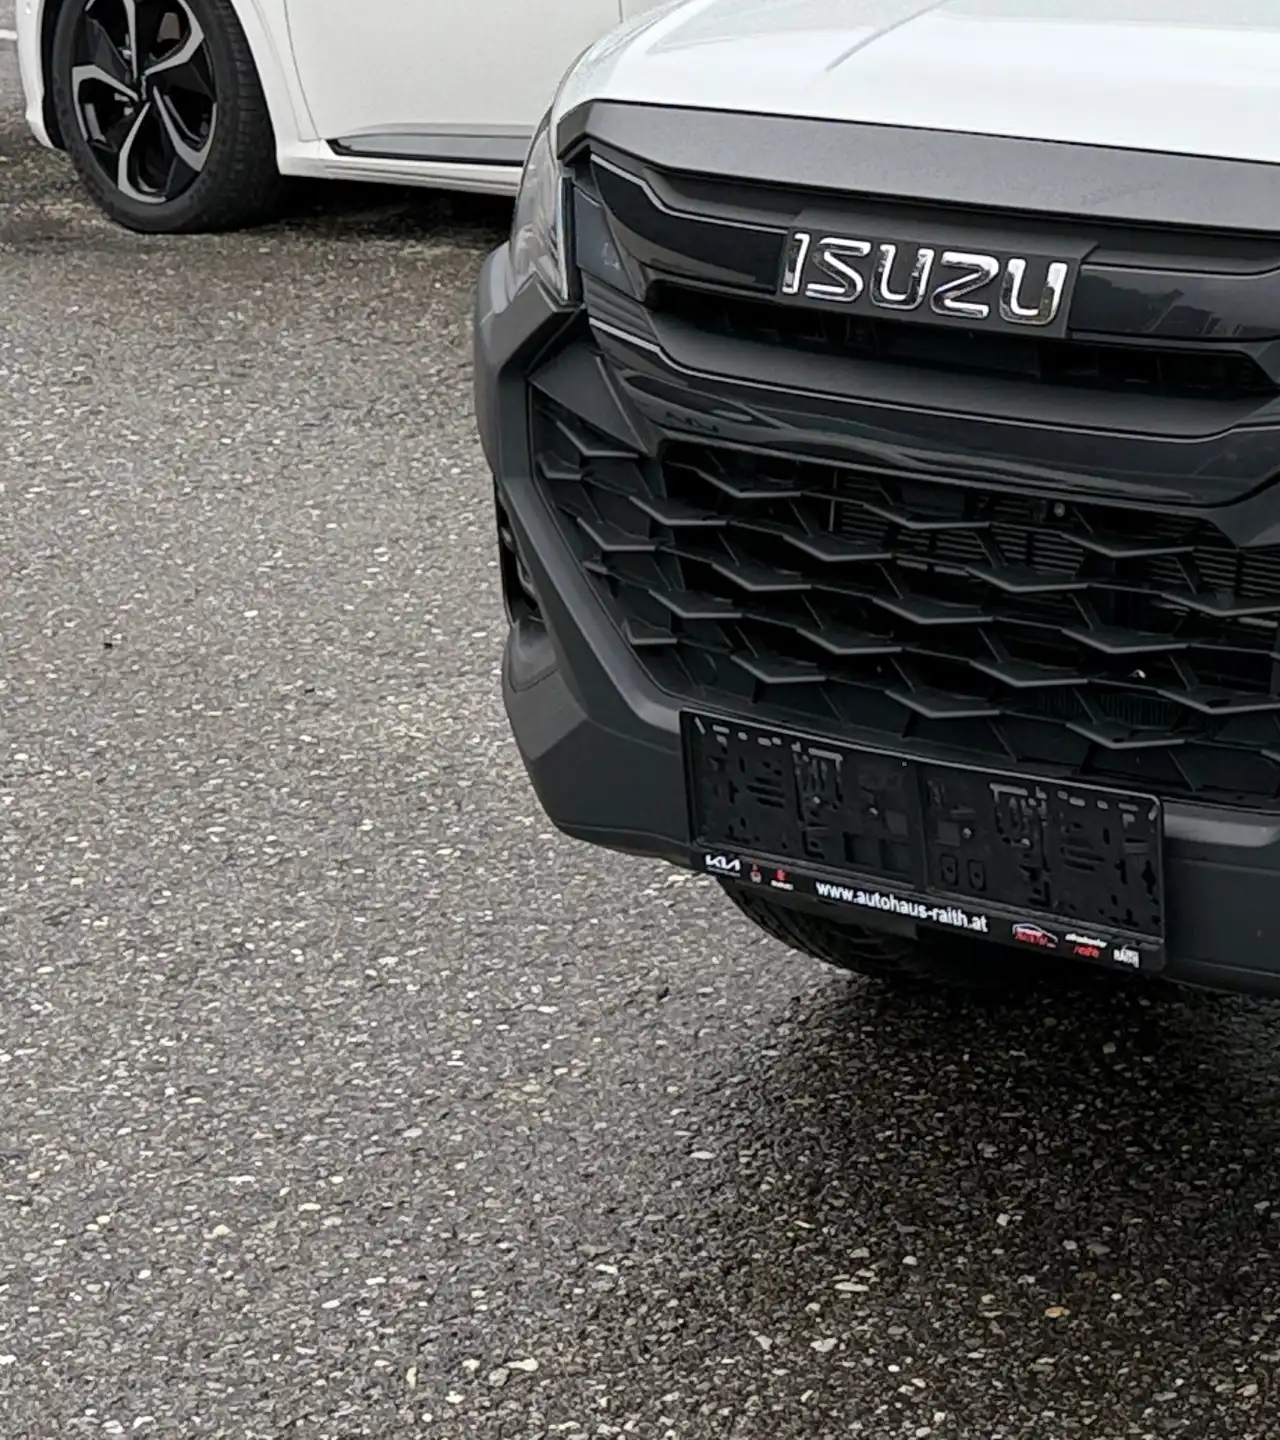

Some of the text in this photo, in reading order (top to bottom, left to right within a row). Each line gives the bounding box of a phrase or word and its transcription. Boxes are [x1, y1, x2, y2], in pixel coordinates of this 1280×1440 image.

[782, 232, 1068, 327] ISUZU
[705, 854, 741, 872] KIA
[814, 880, 989, 933] www.autohaus-raith.at
